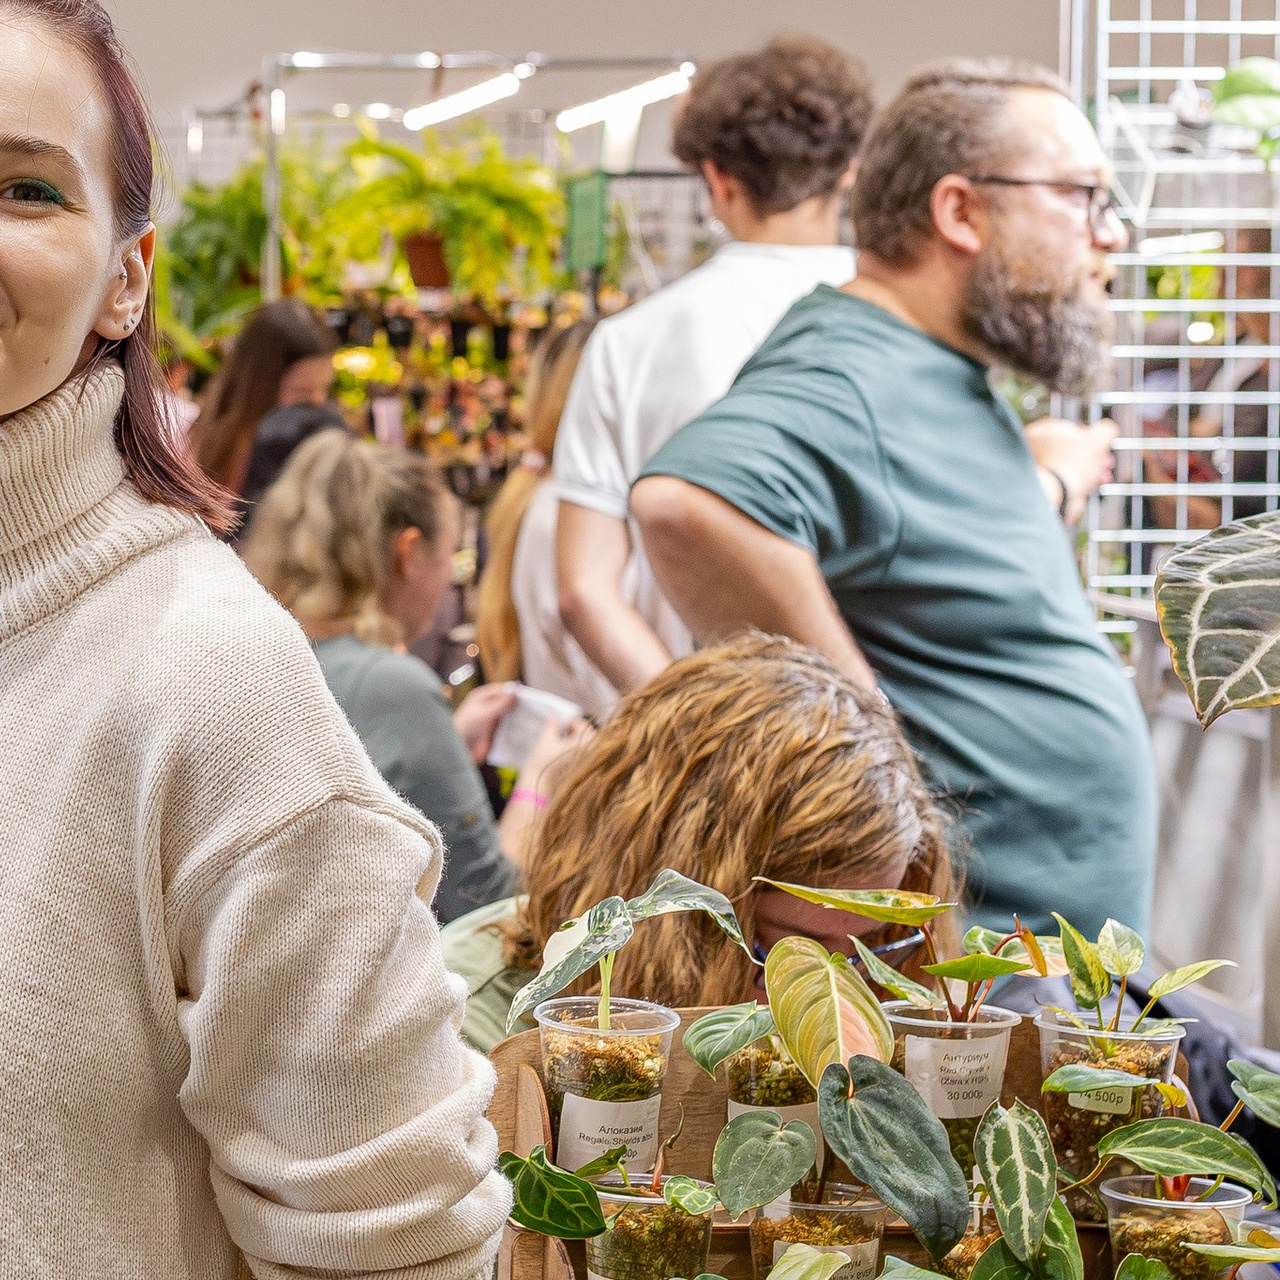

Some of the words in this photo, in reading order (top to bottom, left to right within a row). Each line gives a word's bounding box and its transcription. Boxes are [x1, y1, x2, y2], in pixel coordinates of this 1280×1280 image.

[947, 1091, 960, 1100] 30
[1095, 1091, 1124, 1105] 500р
[599, 1125, 643, 1135] Алоказия
